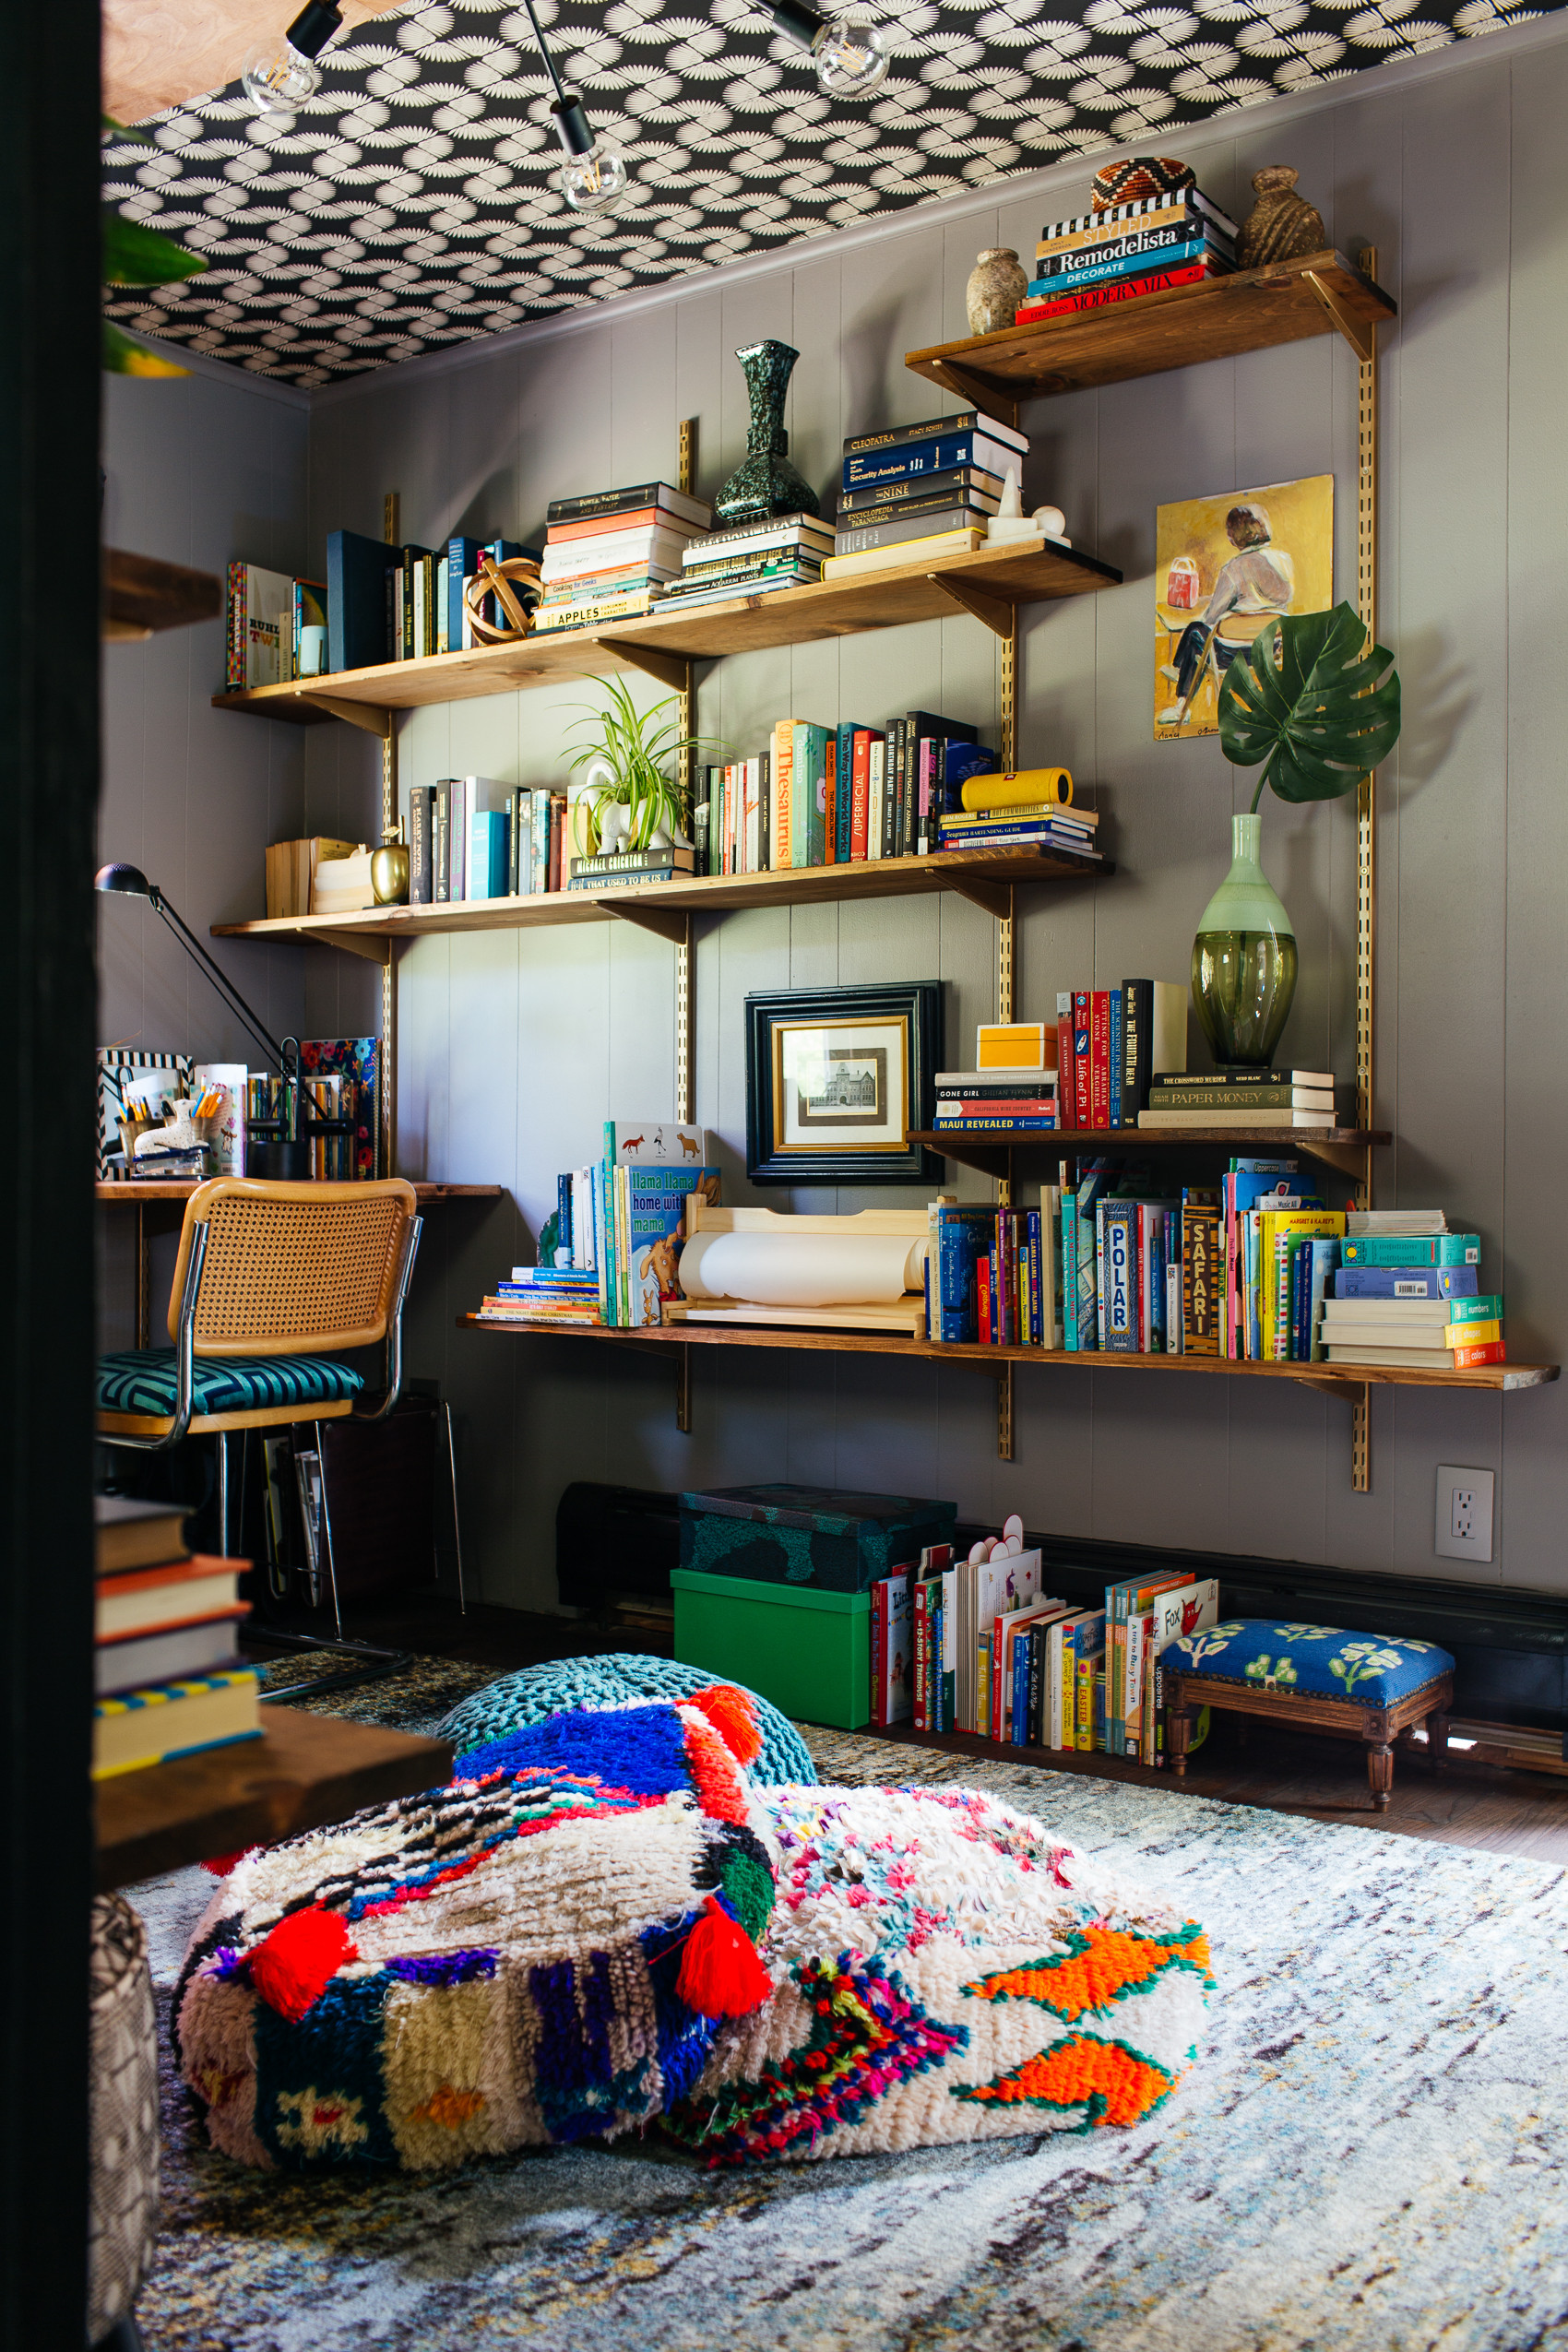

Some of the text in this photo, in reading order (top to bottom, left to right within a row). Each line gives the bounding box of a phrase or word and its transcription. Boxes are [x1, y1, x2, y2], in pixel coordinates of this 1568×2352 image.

[1083, 215, 1151, 245] STYLED
[1059, 230, 1178, 274] Remodelista
[1067, 262, 1124, 283] DECORATE
[1072, 275, 1174, 311] MODERN MIX
[1030, 304, 1069, 318] EDDIE ROSS
[851, 434, 895, 450] CLEOPATRA
[909, 426, 924, 436] STACY
[850, 465, 905, 481] Security Analysis
[883, 484, 909, 499] NINE
[848, 505, 893, 521] ENCYCLOPEDIA
[731, 555, 746, 566] BOOK
[750, 552, 767, 564] GLENN
[768, 548, 782, 559] BECK
[553, 583, 573, 592] Cooking
[582, 578, 597, 587] Geeks
[841, 732, 849, 751] The
[841, 752, 849, 772] Way
[778, 745, 793, 858] Thesaurus
[840, 790, 849, 820] World
[854, 772, 865, 837] SUPERFICIAL
[955, 813, 975, 821] ROGERS
[609, 853, 643, 871] CRICHTON
[587, 874, 660, 889] THAT USED TO BE US
[1126, 1019, 1135, 1032] THE
[1115, 1054, 1120, 1063] IN
[1126, 1034, 1137, 1066] FOURTH
[1078, 1059, 1087, 1107] Life of Pi
[1125, 1068, 1134, 1086] BEAR
[1174, 1076, 1203, 1085] CROSSWORD
[1171, 1092, 1263, 1104] PAPER MONEY
[939, 1120, 1014, 1129] MAUI REVEALED
[1254, 1162, 1279, 1172] Uppercase
[632, 1172, 694, 1190] llama llama
[633, 1193, 686, 1211] home with
[633, 1218, 665, 1232] mama
[1112, 1228, 1126, 1326] POLAR
[1193, 1224, 1207, 1333] SAFARI
[979, 1284, 988, 1317] CORDUROY
[1467, 1303, 1490, 1314] numbers
[1463, 1328, 1481, 1339] shapes
[1471, 1350, 1486, 1360] colors
[1128, 1655, 1137, 1676] Busy
